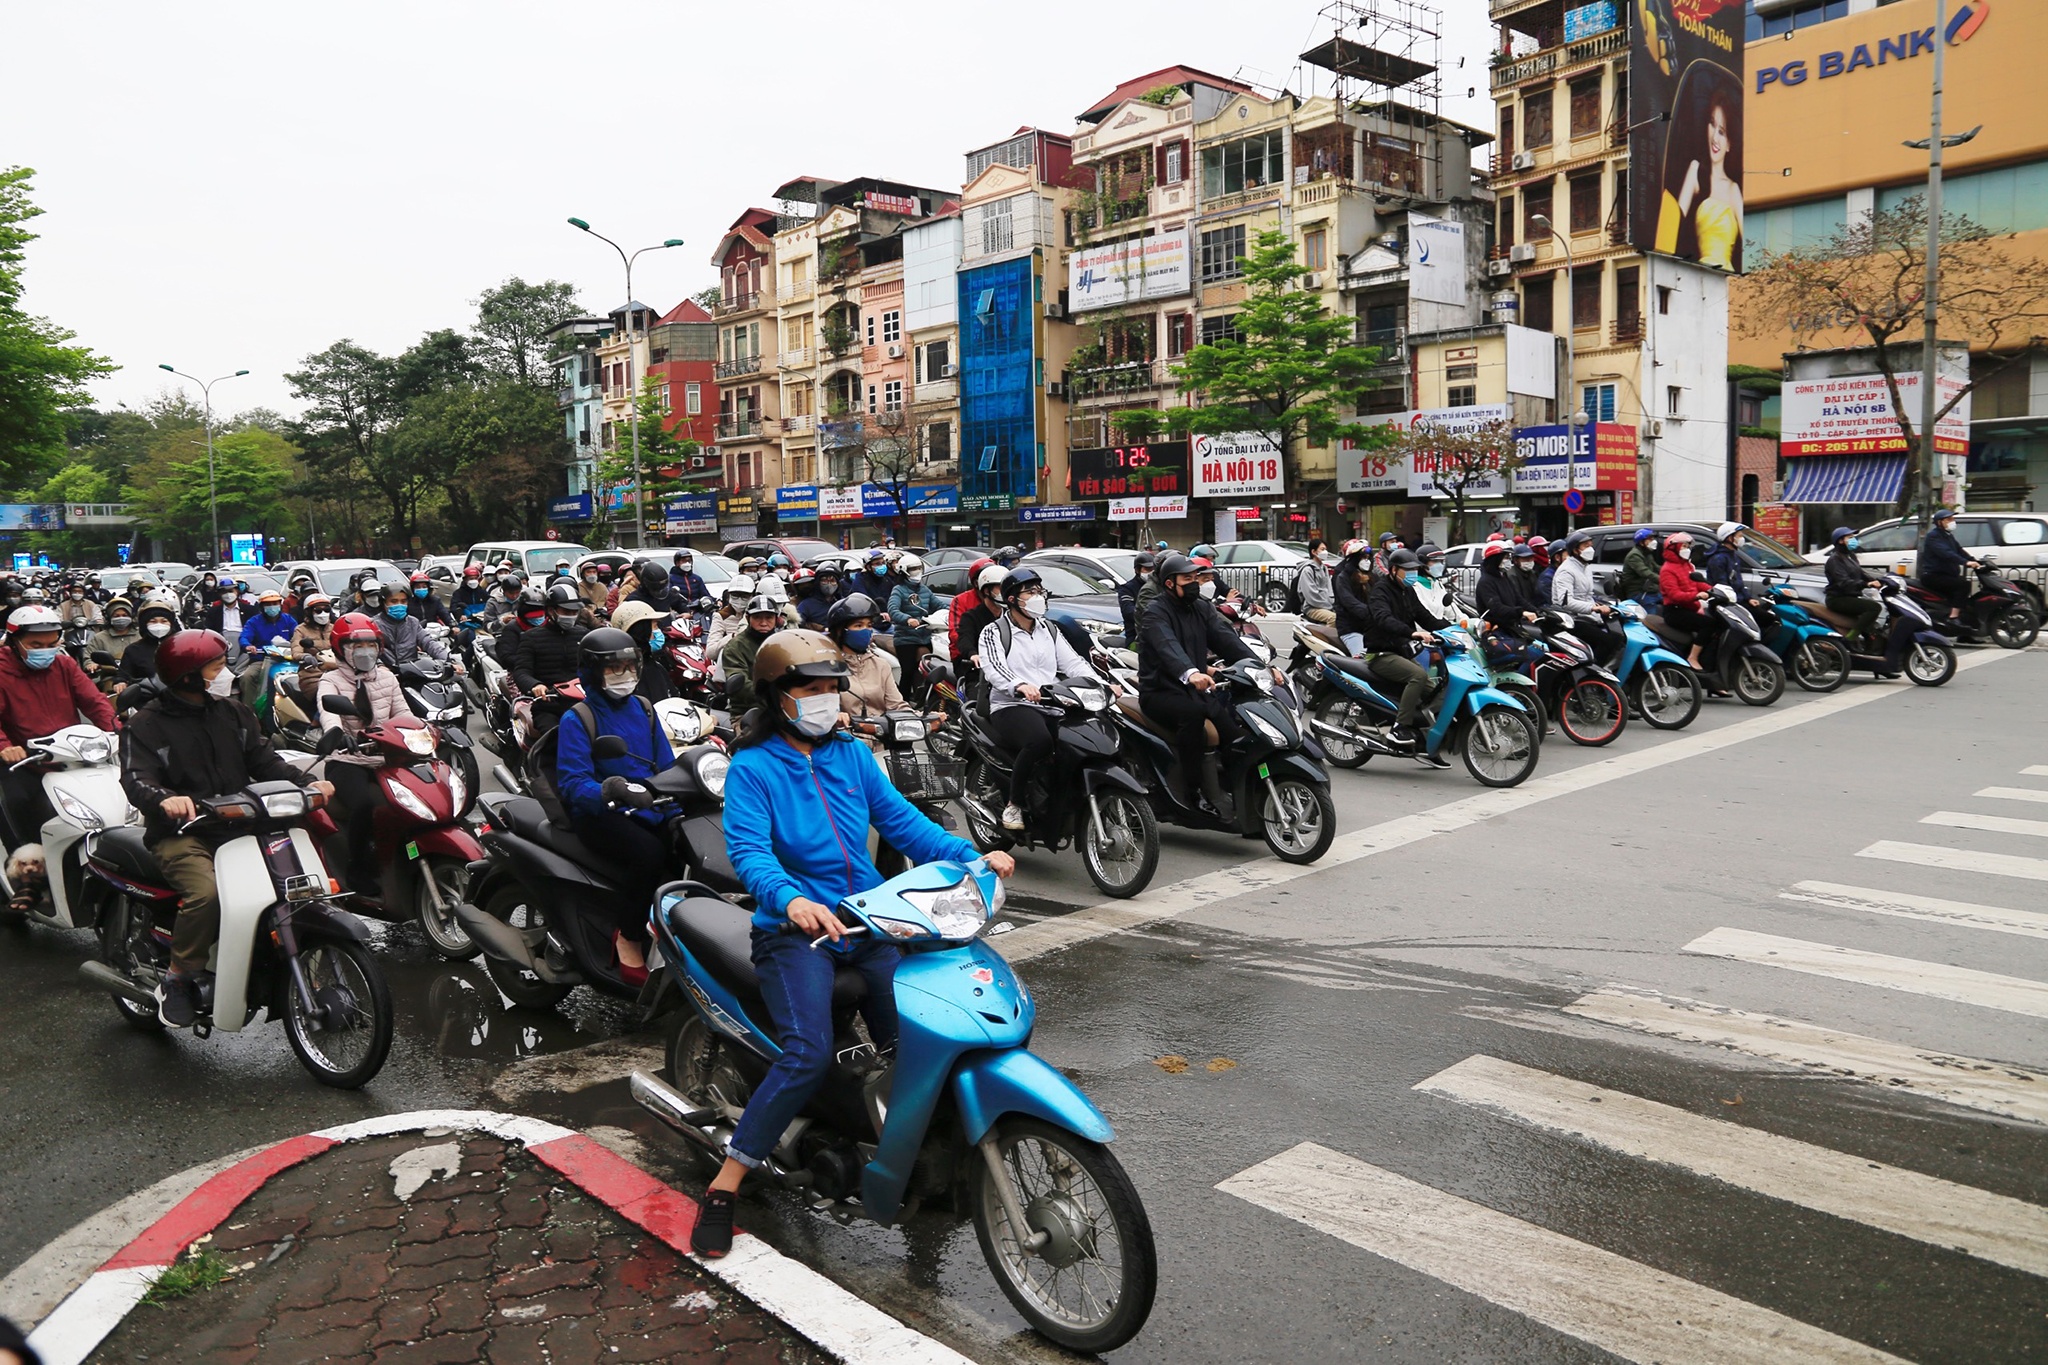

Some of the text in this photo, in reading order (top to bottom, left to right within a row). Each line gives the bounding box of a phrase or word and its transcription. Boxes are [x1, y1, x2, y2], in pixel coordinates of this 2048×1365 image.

[1707, 25, 1733, 53] THÂN
[1755, 25, 1936, 93] PG BANK
[1795, 384, 1814, 394] CÔNG
[1816, 383, 1825, 393] TY
[1907, 375, 1918, 385] ĐÔ
[1824, 394, 1842, 405] ĐẠI
[1858, 391, 1877, 401] CẤP
[1880, 392, 1885, 400] 1
[1822, 403, 1887, 416] HÀ NỘI 8B
[1836, 416, 1869, 427] TRUYỀN
[1214, 444, 1234, 456] TỔNG
[1235, 445, 1248, 456] ĐẠI
[1250, 444, 1258, 454] LÝ
[1536, 434, 1590, 457] MOBLE
[1801, 438, 1908, 454] ĐC: 205 TÂY SƠN
[1202, 458, 1277, 485] HÀ NỘI 18
[1360, 456, 1387, 478] 18
[1542, 469, 1559, 481] THOẠI
[1560, 466, 1568, 479] CŨ
[1579, 466, 1591, 478] CAO
[1078, 473, 1100, 495] YẾN
[1103, 473, 1126, 494] SÀO
[1208, 487, 1219, 495] ĐỊA
[1245, 485, 1256, 493] TÂY
[1372, 479, 1383, 487] TÂY
[1384, 478, 1396, 486] SƠN
[1478, 480, 1491, 489] SƠN
[125, 883, 157, 898] Dream
[154, 925, 173, 937] HONDA
[958, 959, 987, 971] HONDA
